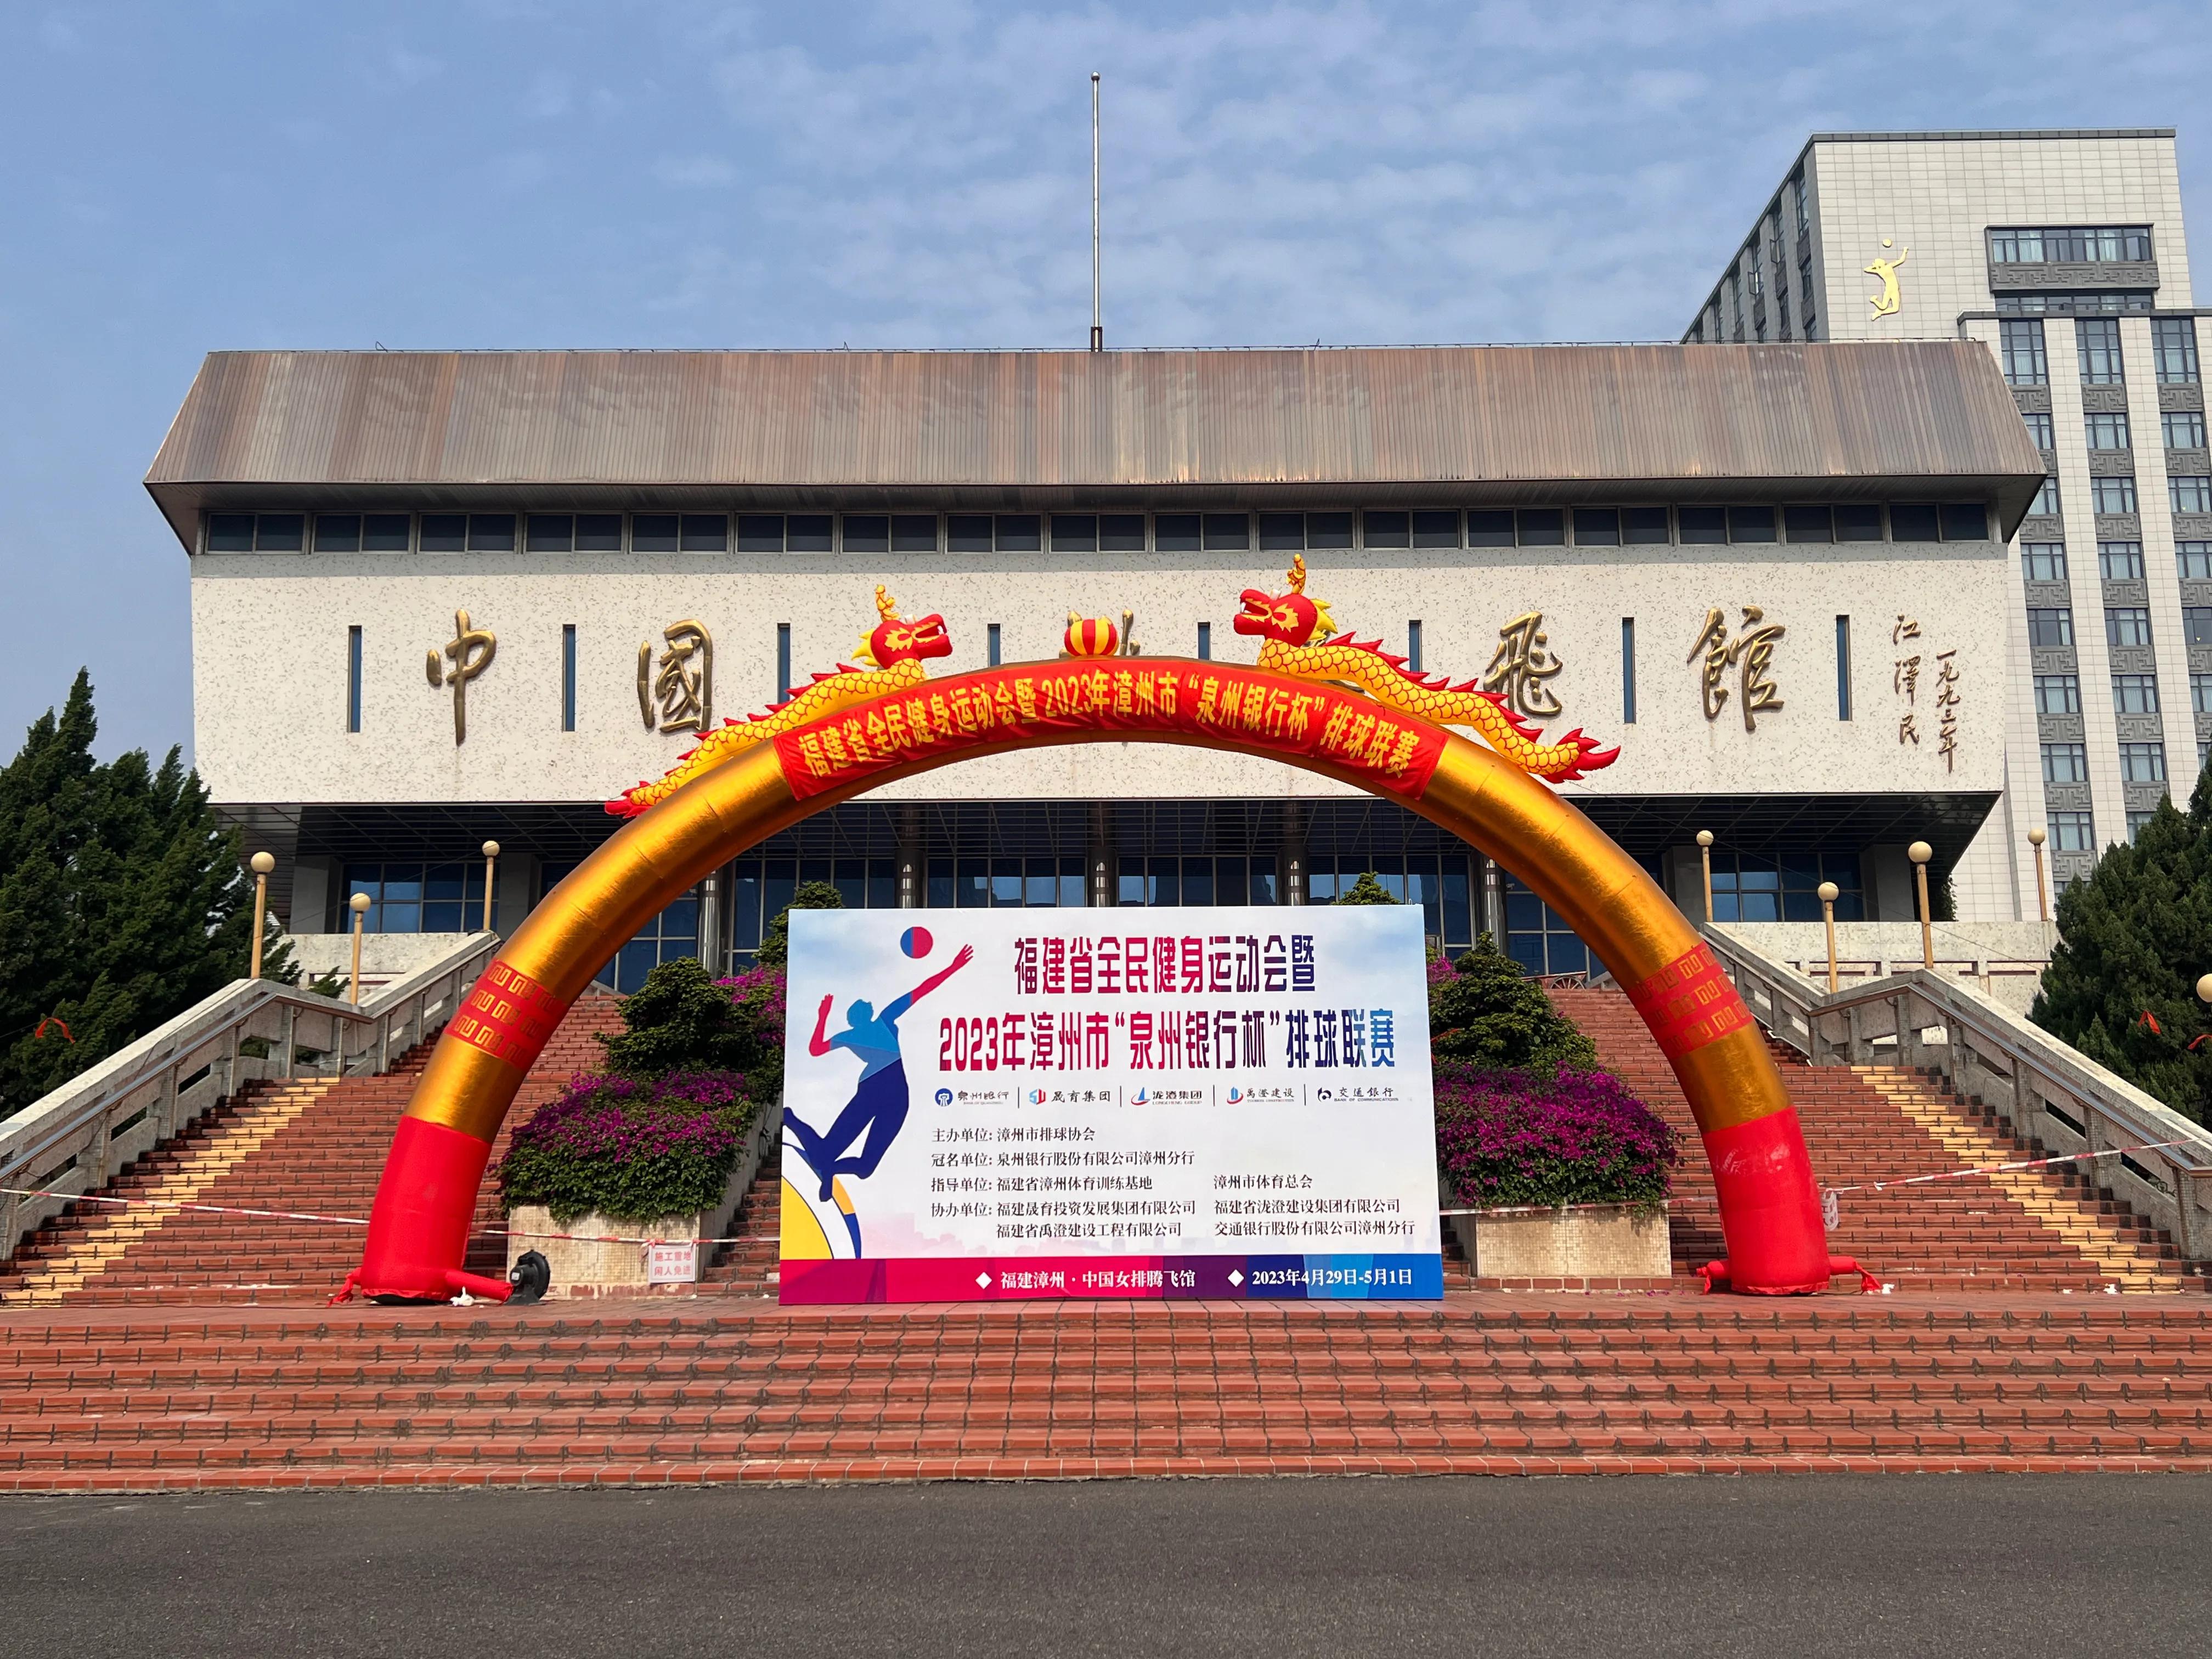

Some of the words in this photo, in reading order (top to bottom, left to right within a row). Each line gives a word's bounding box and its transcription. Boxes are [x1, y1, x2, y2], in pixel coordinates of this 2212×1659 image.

[1014, 934, 1316, 995] 福建省全民健身运动会暨
[1052, 1090, 1110, 1103] 晟育集团
[1214, 1174, 1313, 1189] 漳州市体育总会
[1214, 1198, 1400, 1215] 福建省泷澄建设集团有限公司
[996, 1222, 1182, 1238] 福建省禹澄建设工程有限公司
[1214, 1220, 1416, 1236] 交通银行股份有限公司漳州分行
[1251, 1268, 1412, 1285] 2023年4月29日-5月1日
